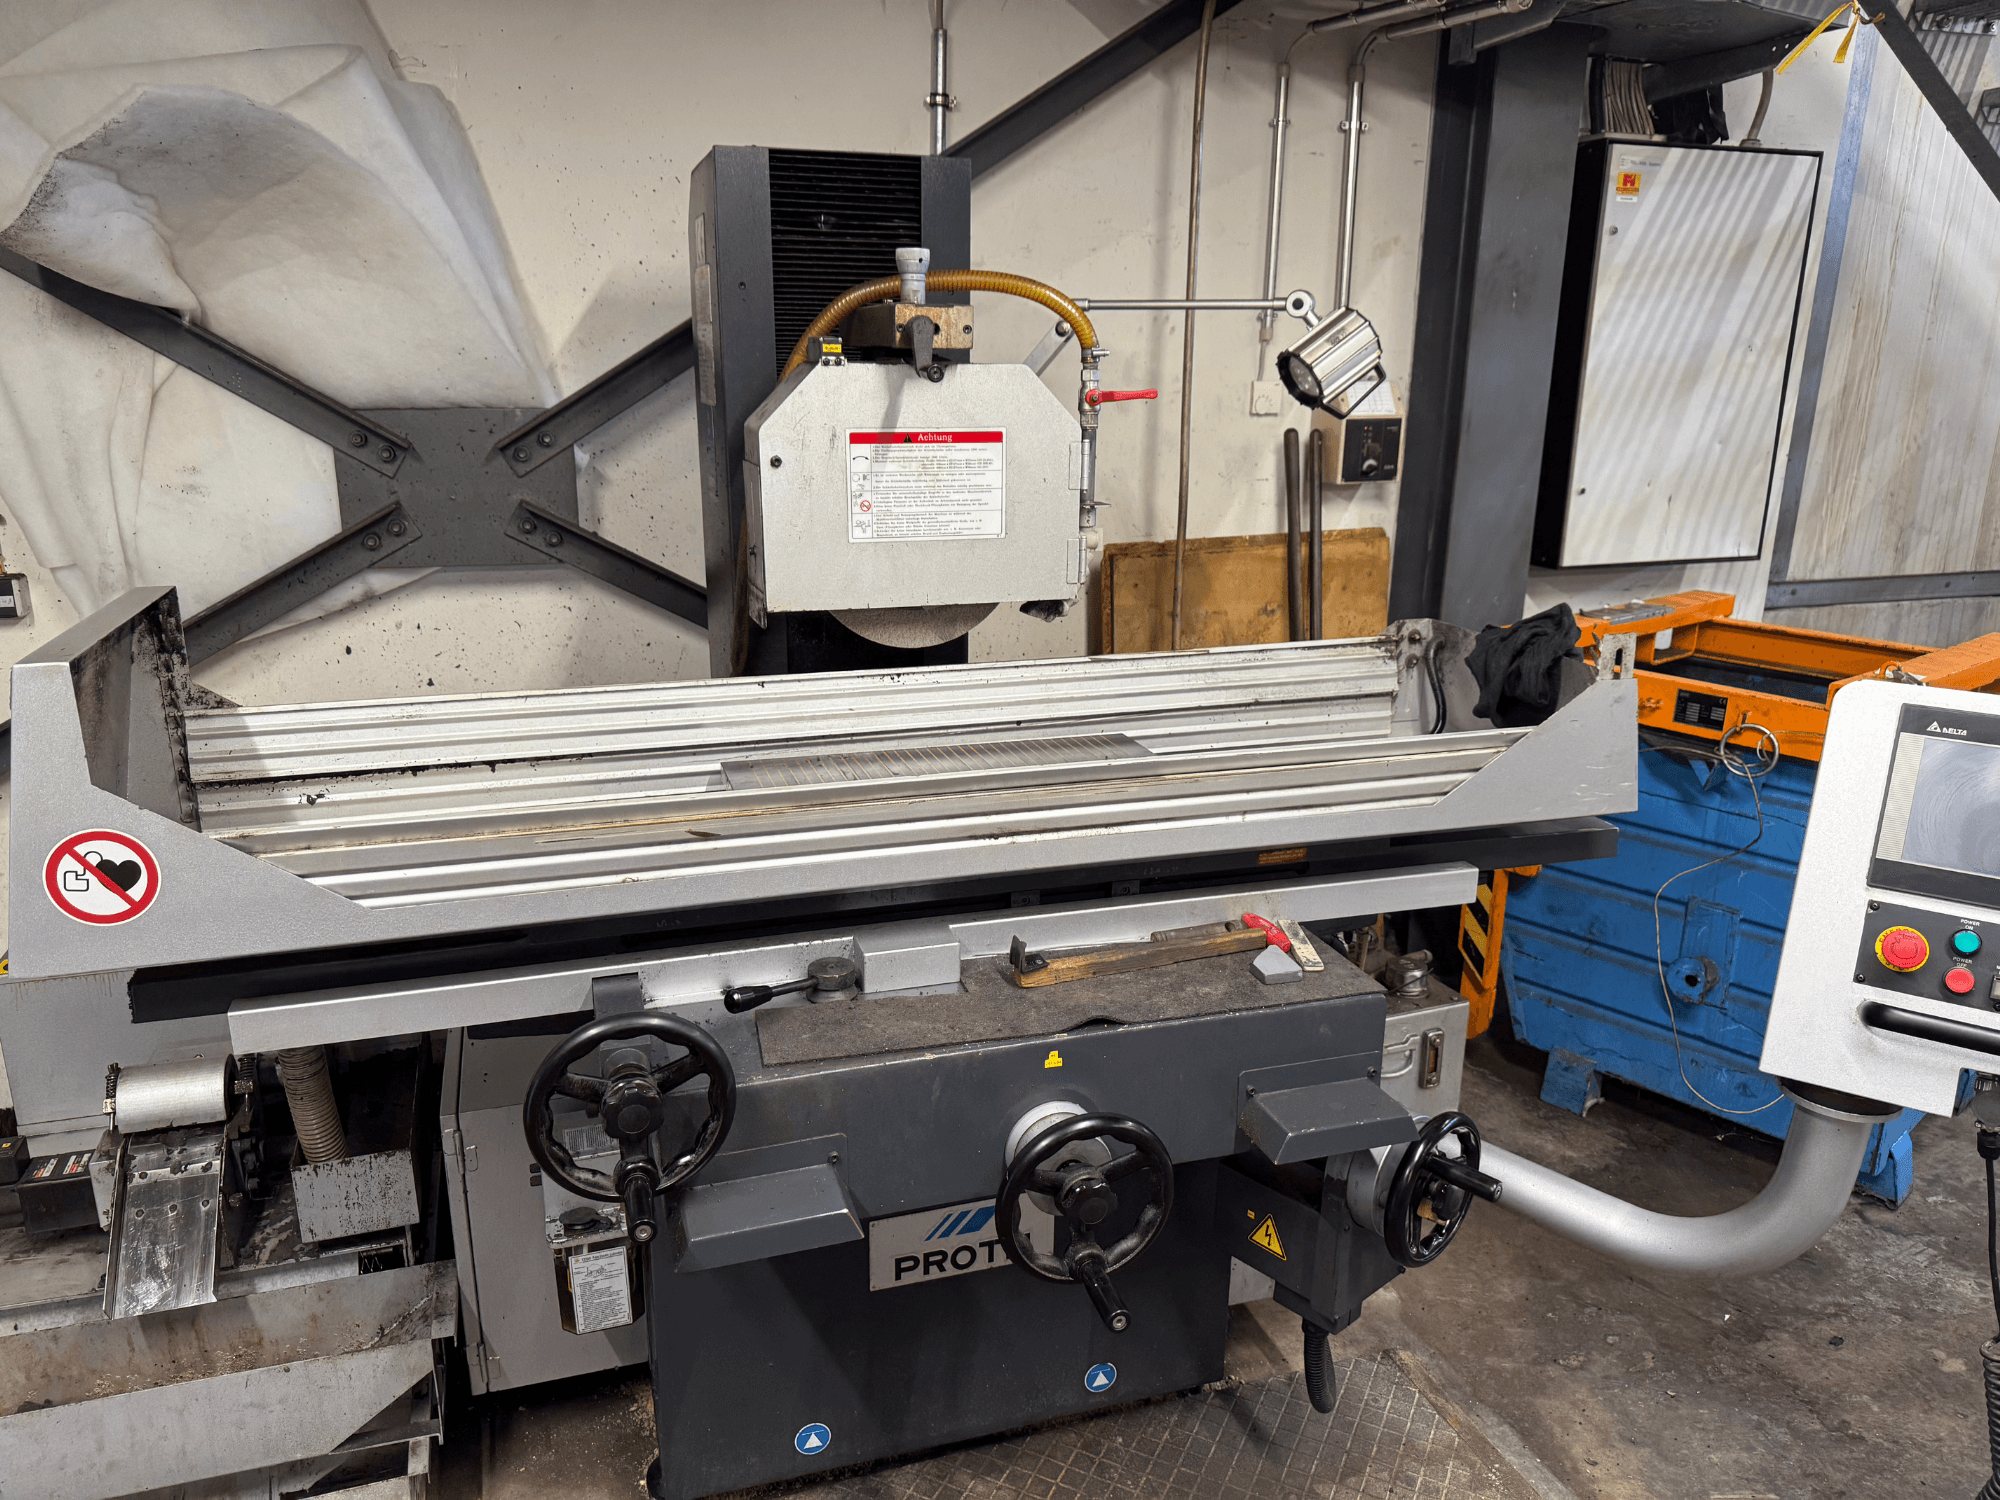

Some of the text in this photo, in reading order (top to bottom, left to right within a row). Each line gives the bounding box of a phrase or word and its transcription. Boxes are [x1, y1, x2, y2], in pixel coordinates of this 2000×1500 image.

[918, 432, 952, 442] Achtung
[1942, 727, 1967, 736] DELTA
[1960, 918, 1981, 926] POWER
[1952, 956, 1973, 964] POWER
[895, 1233, 1030, 1281] PROT
